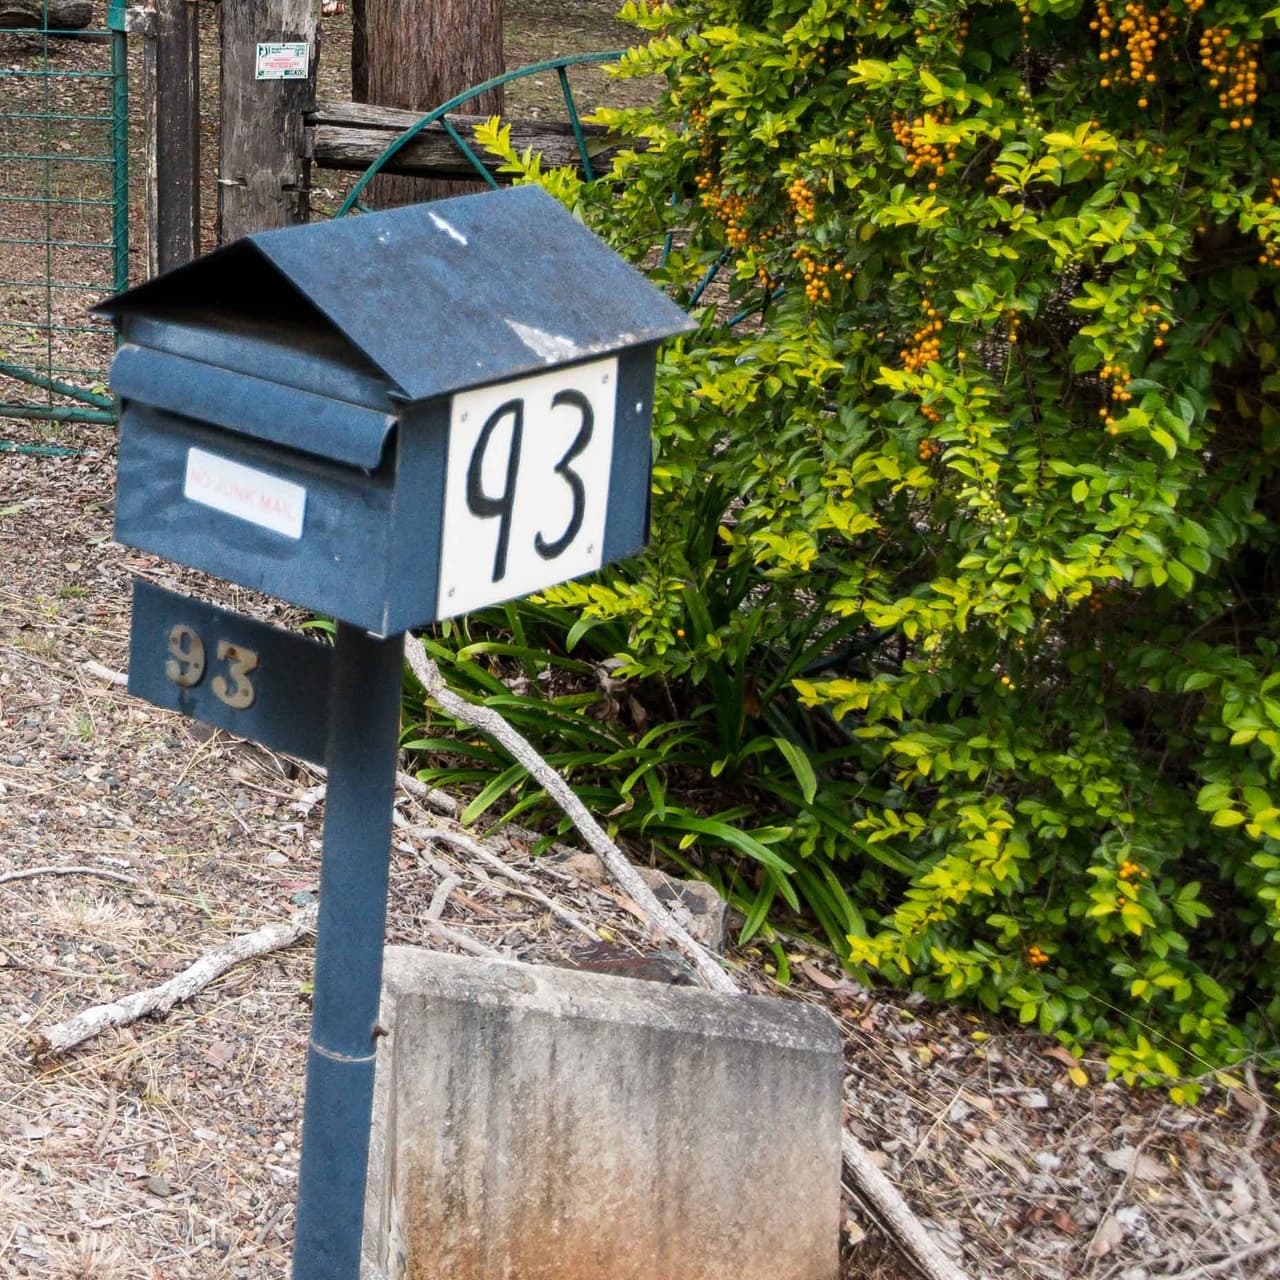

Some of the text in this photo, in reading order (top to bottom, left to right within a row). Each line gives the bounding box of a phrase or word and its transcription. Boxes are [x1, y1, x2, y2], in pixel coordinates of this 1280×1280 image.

[189, 468, 210, 488] NO
[466, 389, 594, 582] 93
[165, 623, 259, 710] 93
